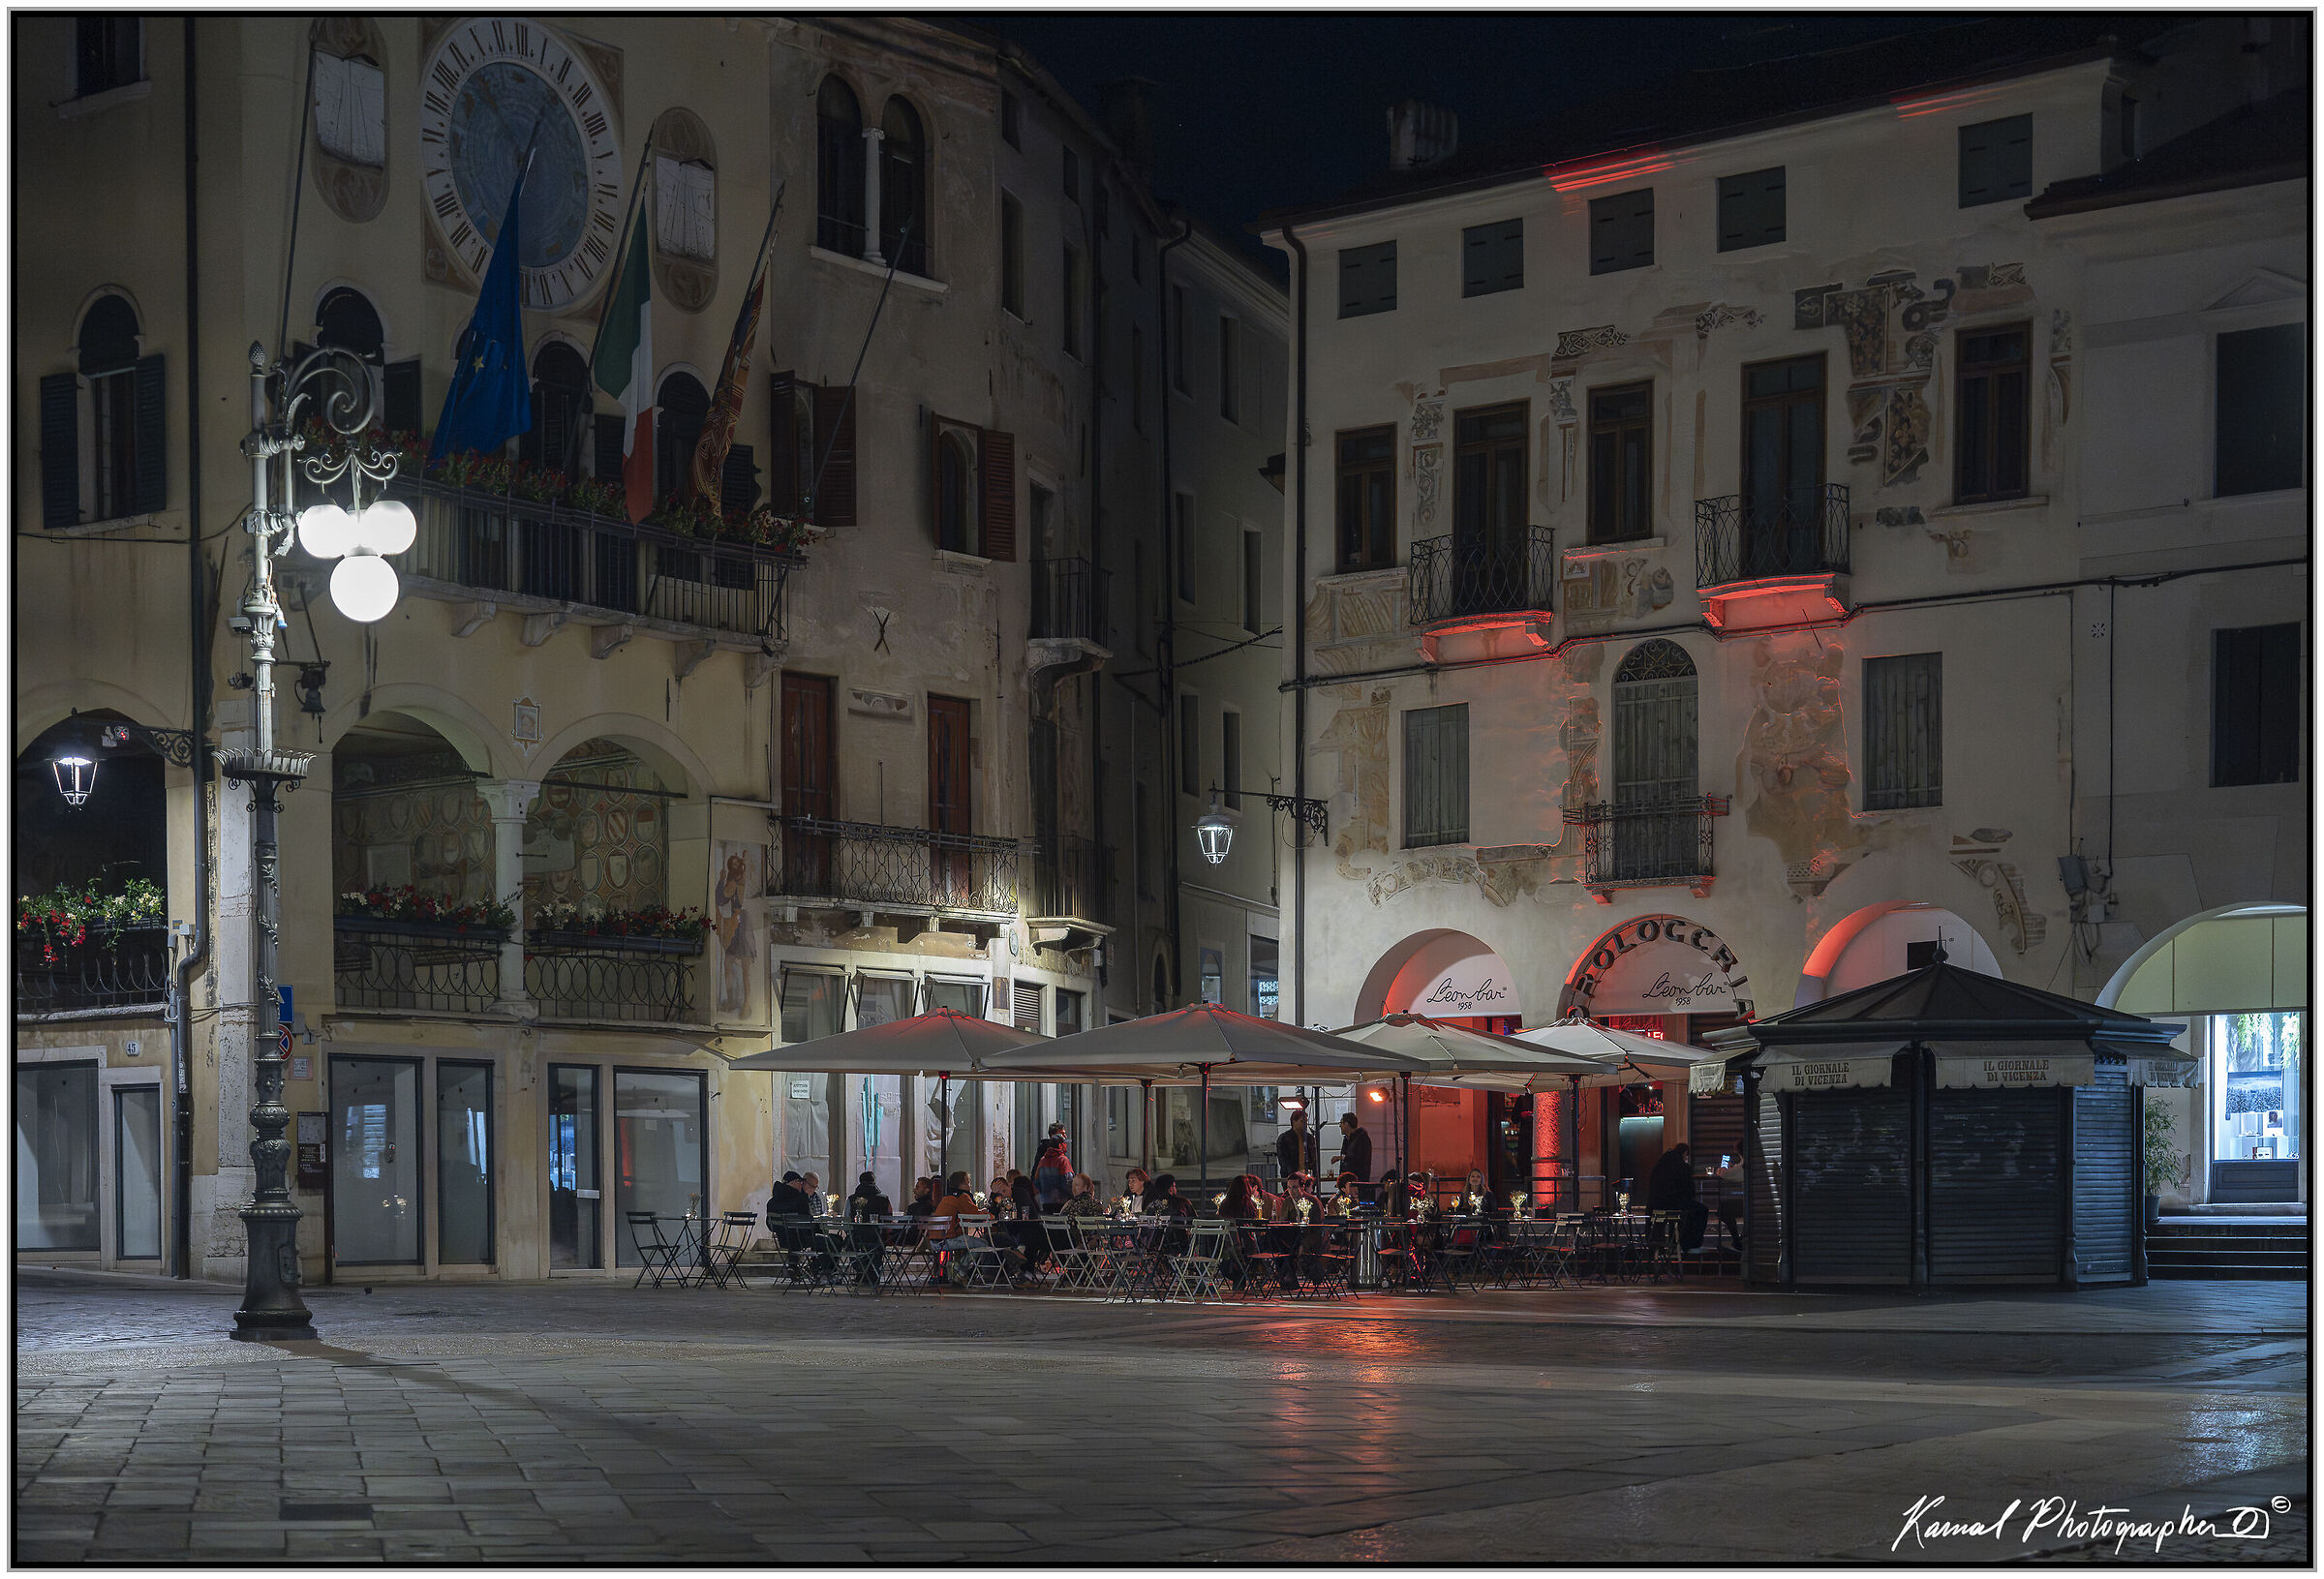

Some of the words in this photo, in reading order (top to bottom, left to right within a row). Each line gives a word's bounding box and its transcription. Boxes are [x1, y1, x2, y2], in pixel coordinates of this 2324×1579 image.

[1457, 1001, 1473, 1010] 1958
[1675, 997, 1692, 1006] 1958
[127, 1043, 137, 1053] 45
[1791, 1065, 1802, 1076] IL
[1804, 1062, 1850, 1075] GIORNALE
[1983, 1060, 1995, 1072] IL
[1998, 1059, 2049, 1071] GIORNALE
[1795, 1076, 1805, 1086] DI
[1808, 1074, 1848, 1085] VICENZA
[1987, 1072, 1999, 1082] DI
[2002, 1071, 2047, 1081] VICENZA
